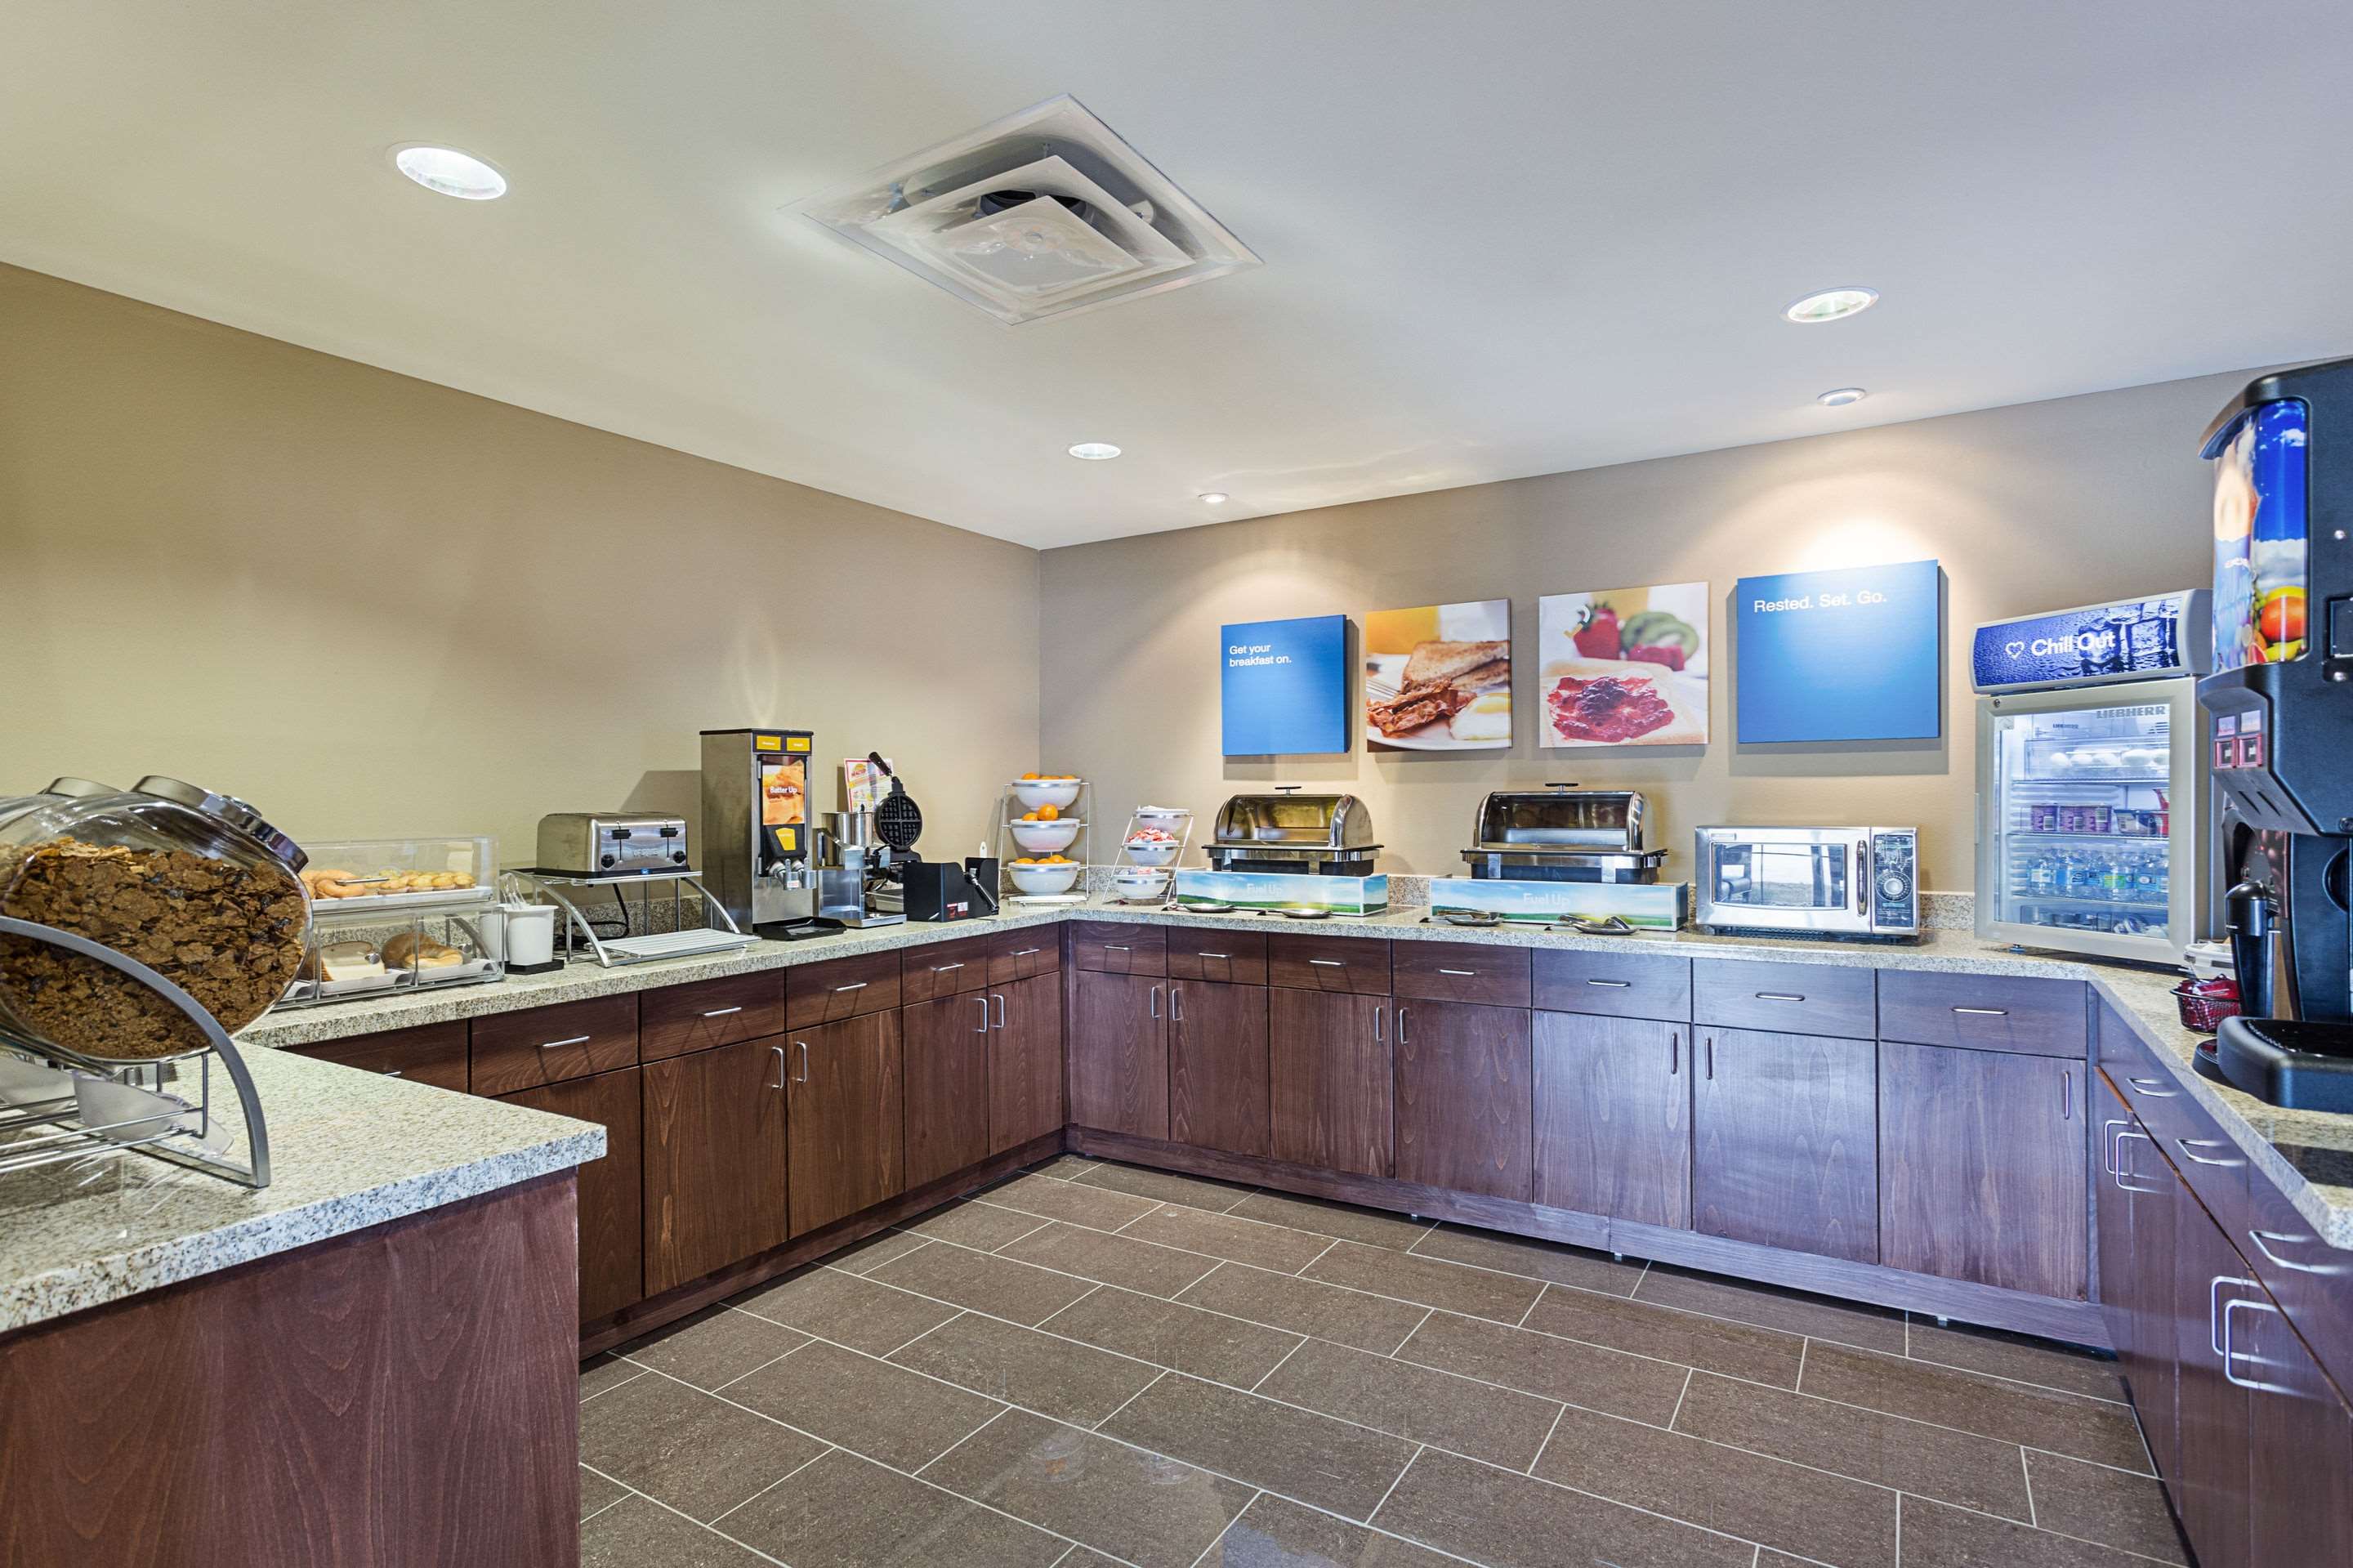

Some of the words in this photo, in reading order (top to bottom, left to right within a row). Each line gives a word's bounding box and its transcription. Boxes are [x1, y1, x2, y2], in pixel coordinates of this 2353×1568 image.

[1753, 596, 1814, 614] Rested.
[1819, 592, 1851, 608] Set.
[1856, 590, 1886, 605] Go.
[1229, 645, 1248, 654] Get
[1248, 644, 1271, 655] your
[2030, 634, 2073, 657] Chill
[2077, 631, 2116, 651] Out
[1229, 655, 1275, 668] breakfast
[1275, 655, 1293, 664] on.
[2096, 705, 2166, 719] LIEBHERR
[788, 786, 797, 795] Up
[1247, 882, 1267, 896] Fuel
[1522, 892, 1549, 904] Fuel
[1551, 893, 1569, 908] Up
